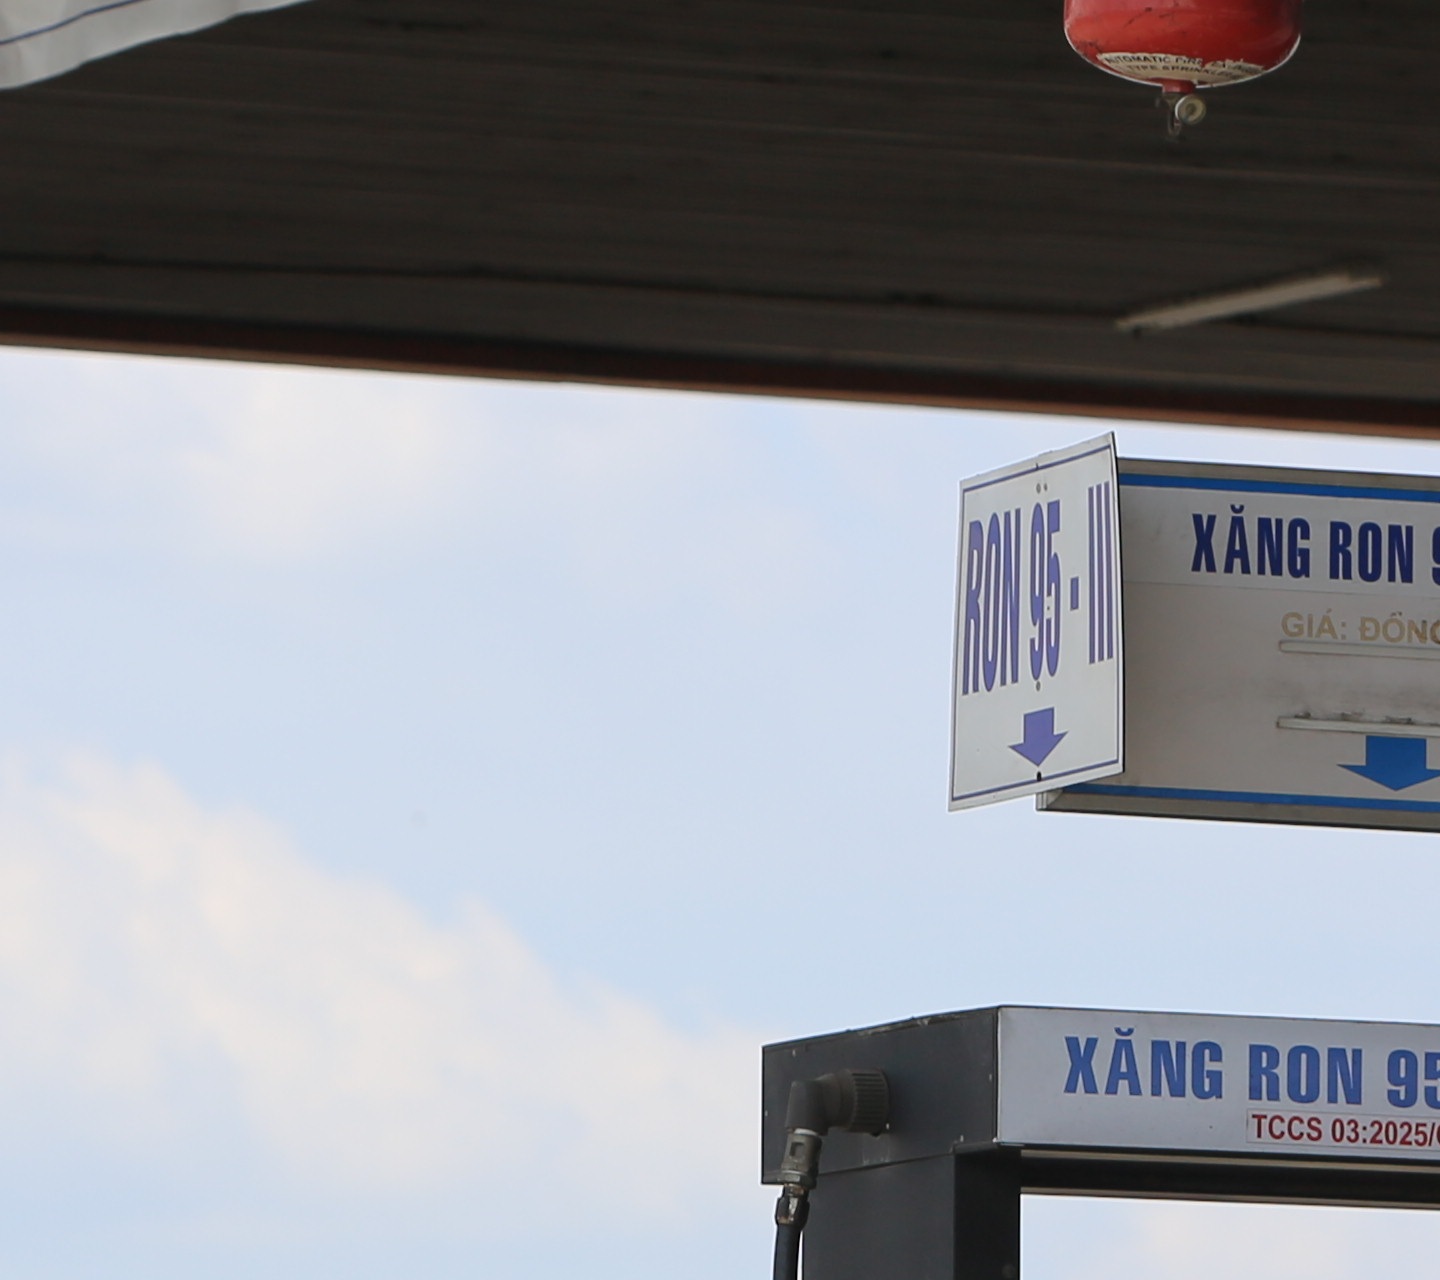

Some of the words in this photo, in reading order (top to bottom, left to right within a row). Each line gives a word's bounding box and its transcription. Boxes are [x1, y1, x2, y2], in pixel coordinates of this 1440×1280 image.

[1191, 504, 1311, 579] XĂNG
[1329, 521, 1414, 584] RON
[962, 507, 1021, 695] RON
[1029, 500, 1060, 680] 95
[1281, 608, 1348, 641] GIÁ:
[1064, 1027, 1224, 1100] XĂNG
[1247, 1043, 1363, 1106] RON
[1251, 1113, 1324, 1143] TCCS
